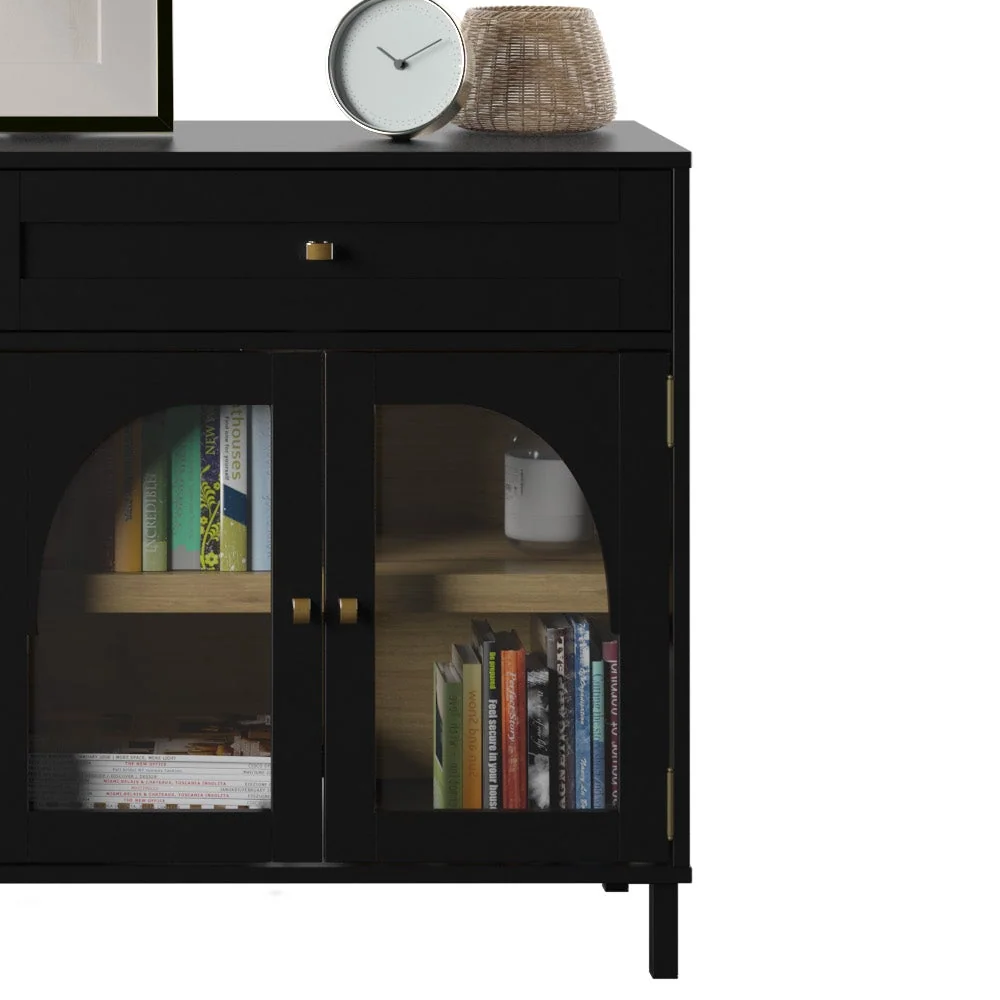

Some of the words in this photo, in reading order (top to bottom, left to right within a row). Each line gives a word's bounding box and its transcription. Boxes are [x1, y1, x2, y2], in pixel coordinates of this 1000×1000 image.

[206, 426, 216, 455] NEW
[506, 672, 516, 708] Perfect
[488, 699, 498, 717] Feel
[488, 719, 497, 750] secure
[508, 713, 516, 742] Story
[489, 752, 498, 761] in
[487, 762, 497, 784] your
